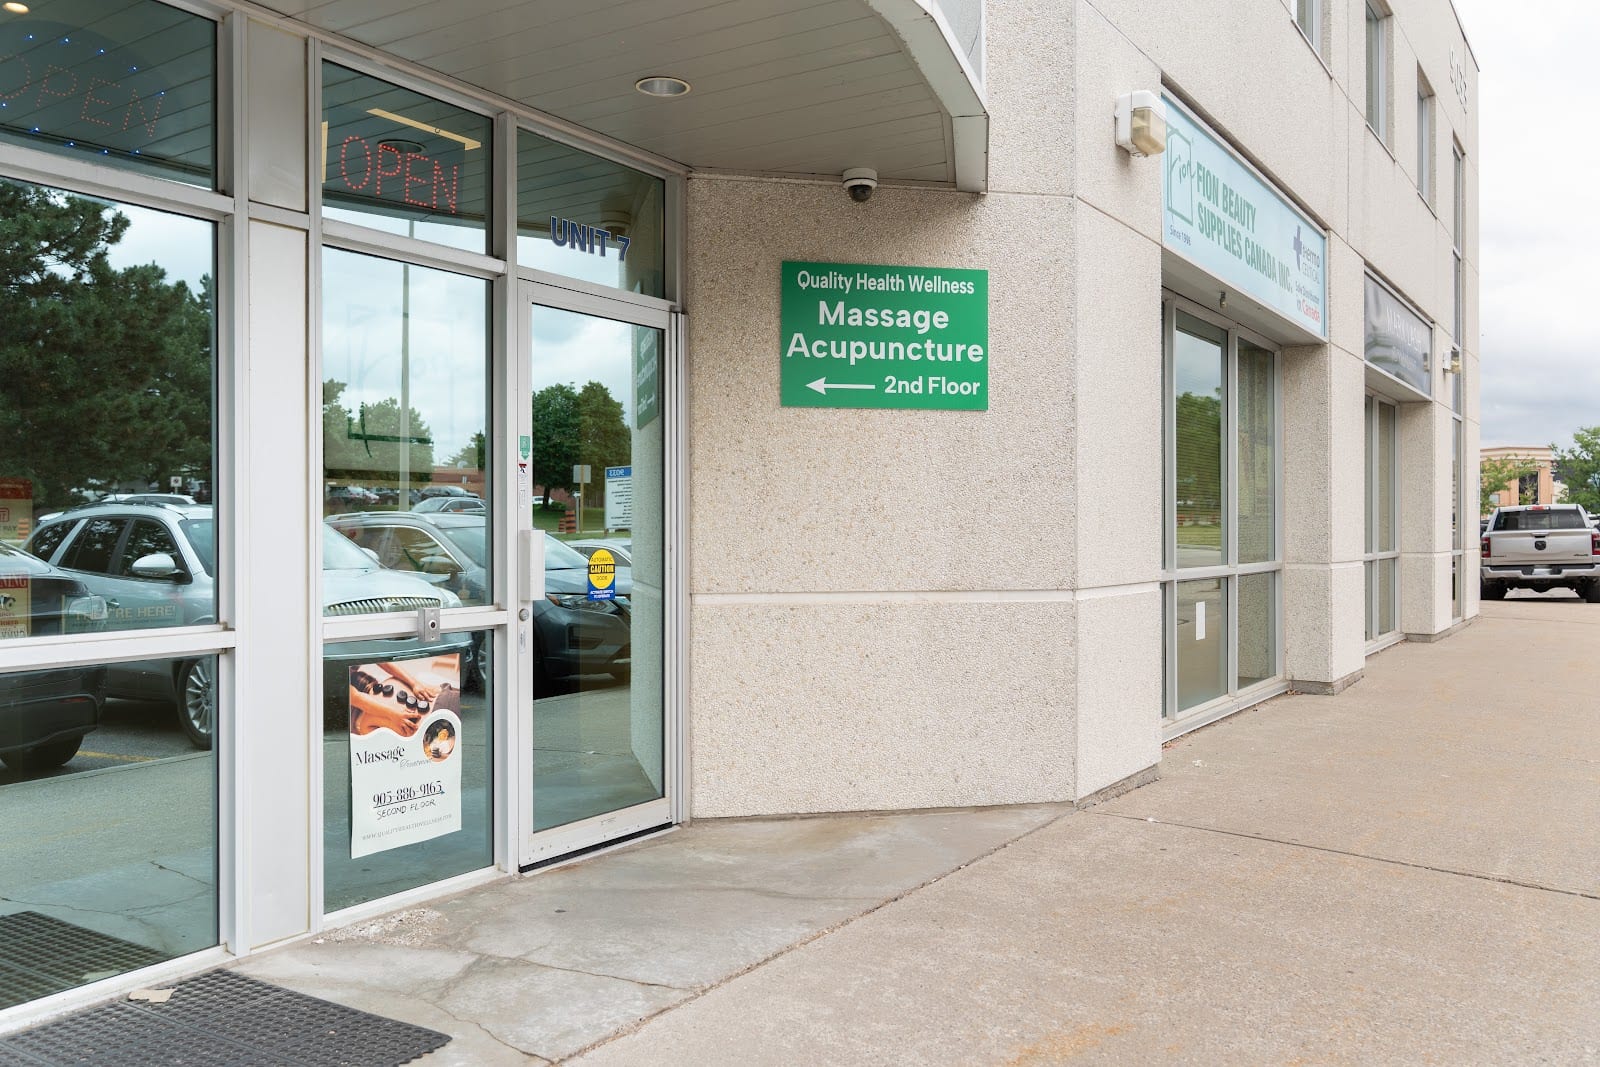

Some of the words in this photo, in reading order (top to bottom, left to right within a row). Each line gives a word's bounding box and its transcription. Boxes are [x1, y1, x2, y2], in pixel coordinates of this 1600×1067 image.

[340, 135, 458, 213] OPEN
[1196, 161, 1219, 207] FION
[1222, 182, 1257, 234] BEAUTY
[550, 215, 612, 258] UNIT
[616, 234, 632, 262] 7
[1169, 224, 1181, 241] Since
[1197, 201, 1243, 261] SUPPLIES
[1244, 236, 1277, 284] CANADA
[1278, 260, 1294, 294] INC.
[797, 270, 853, 294] Quality
[856, 272, 905, 292] Health
[908, 274, 975, 294] Wellness
[818, 300, 950, 335] Massage
[786, 332, 984, 366] Acupuncture
[884, 375, 923, 395] 2nd
[928, 376, 981, 396] Floor
[590, 564, 614, 574] CAUTION
[356, 746, 405, 767] Massage
[373, 782, 442, 805] 905-886-9165
[377, 804, 407, 820] SECOND
[410, 799, 436, 812] FLOOR
